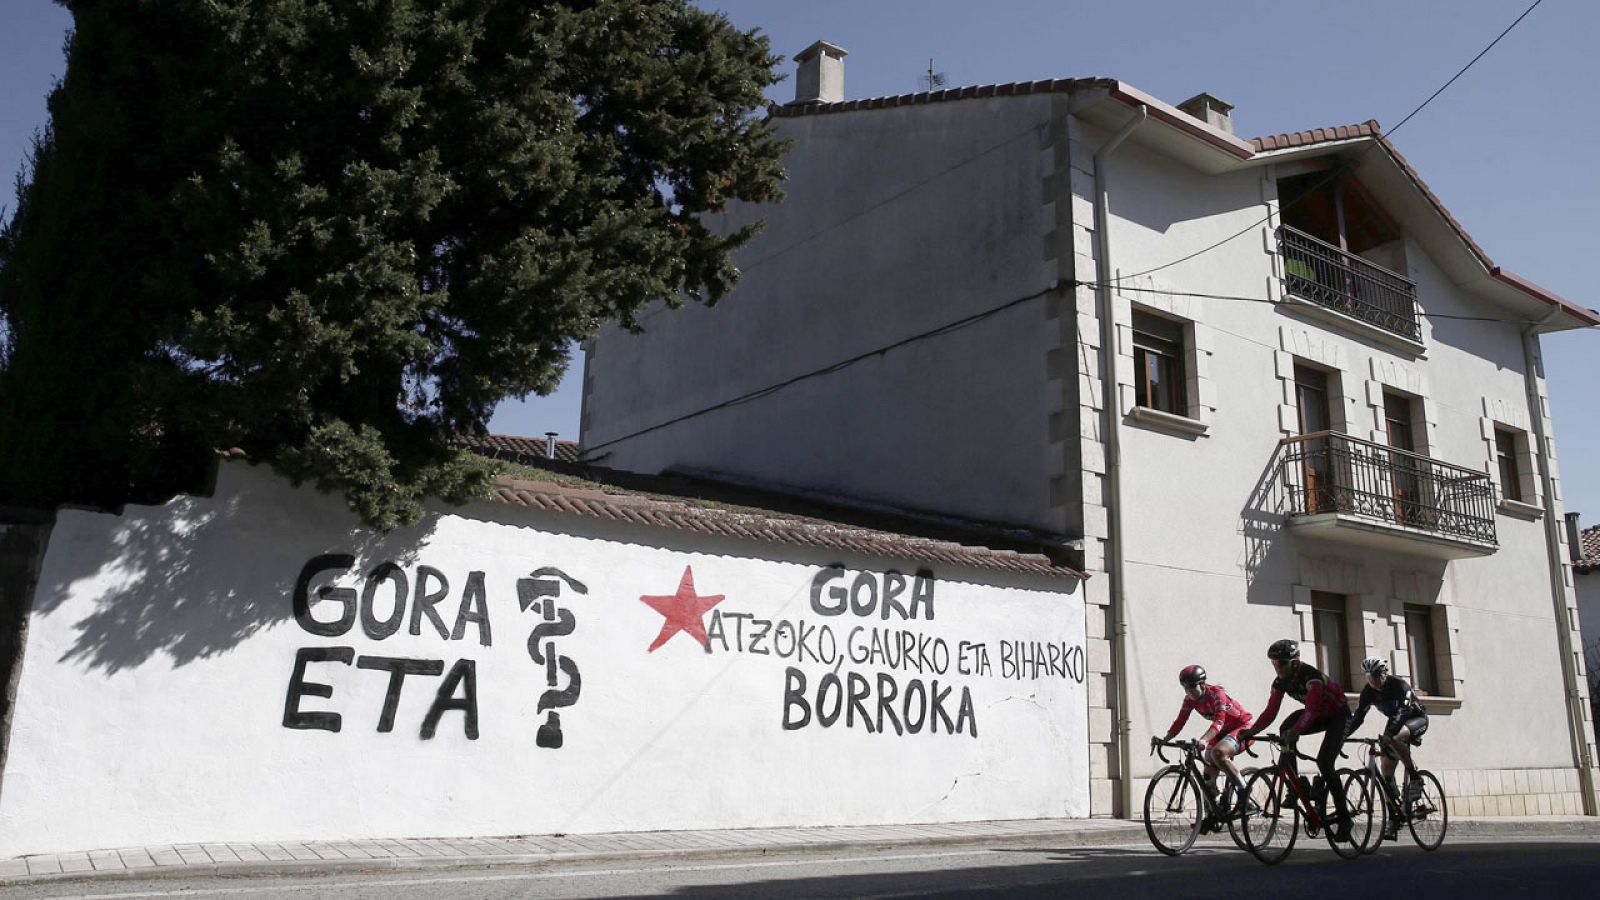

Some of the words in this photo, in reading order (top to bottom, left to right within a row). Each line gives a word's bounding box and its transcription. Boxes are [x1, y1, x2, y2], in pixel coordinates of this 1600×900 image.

[293, 554, 492, 647] GORA
[810, 563, 934, 620] GORA
[705, 609, 844, 674] ATZOKO,
[848, 626, 949, 675] GAURKO
[958, 641, 993, 677] ETA
[1000, 640, 1085, 683] BIHARKO
[282, 646, 479, 740] ETA
[782, 666, 978, 738] BORROKA
